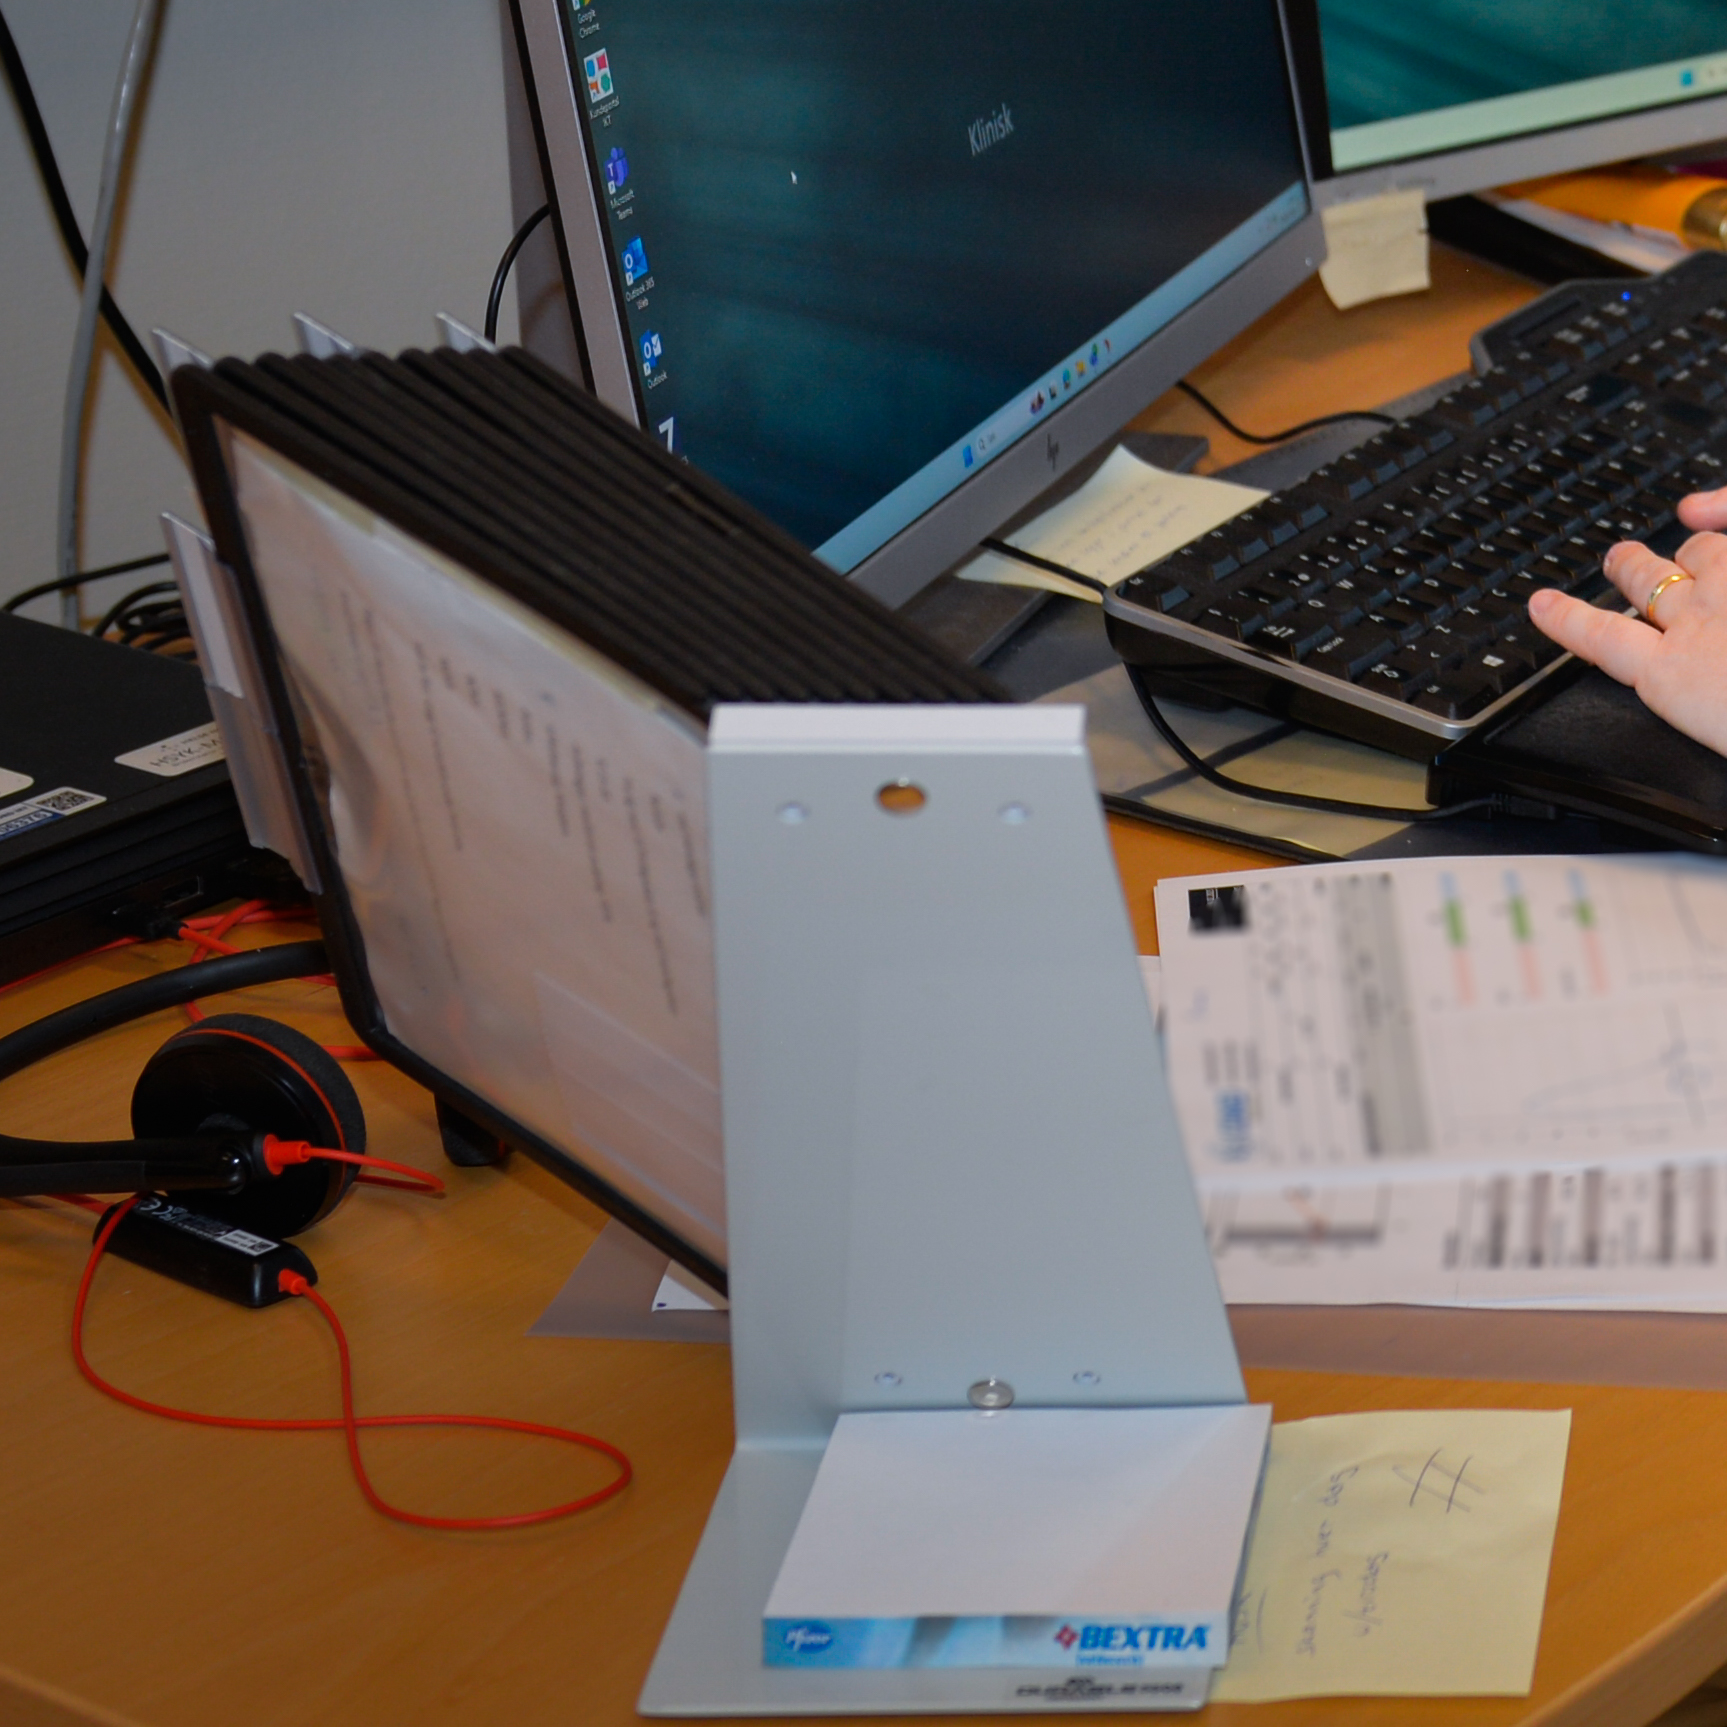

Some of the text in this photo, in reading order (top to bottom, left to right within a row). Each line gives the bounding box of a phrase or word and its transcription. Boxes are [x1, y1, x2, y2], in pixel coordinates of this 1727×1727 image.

[577, 9, 597, 25] Google
[579, 23, 600, 39] Chrome
[967, 102, 1015, 157] Klinisk
[1078, 1623, 1212, 1652] BEXTRA
